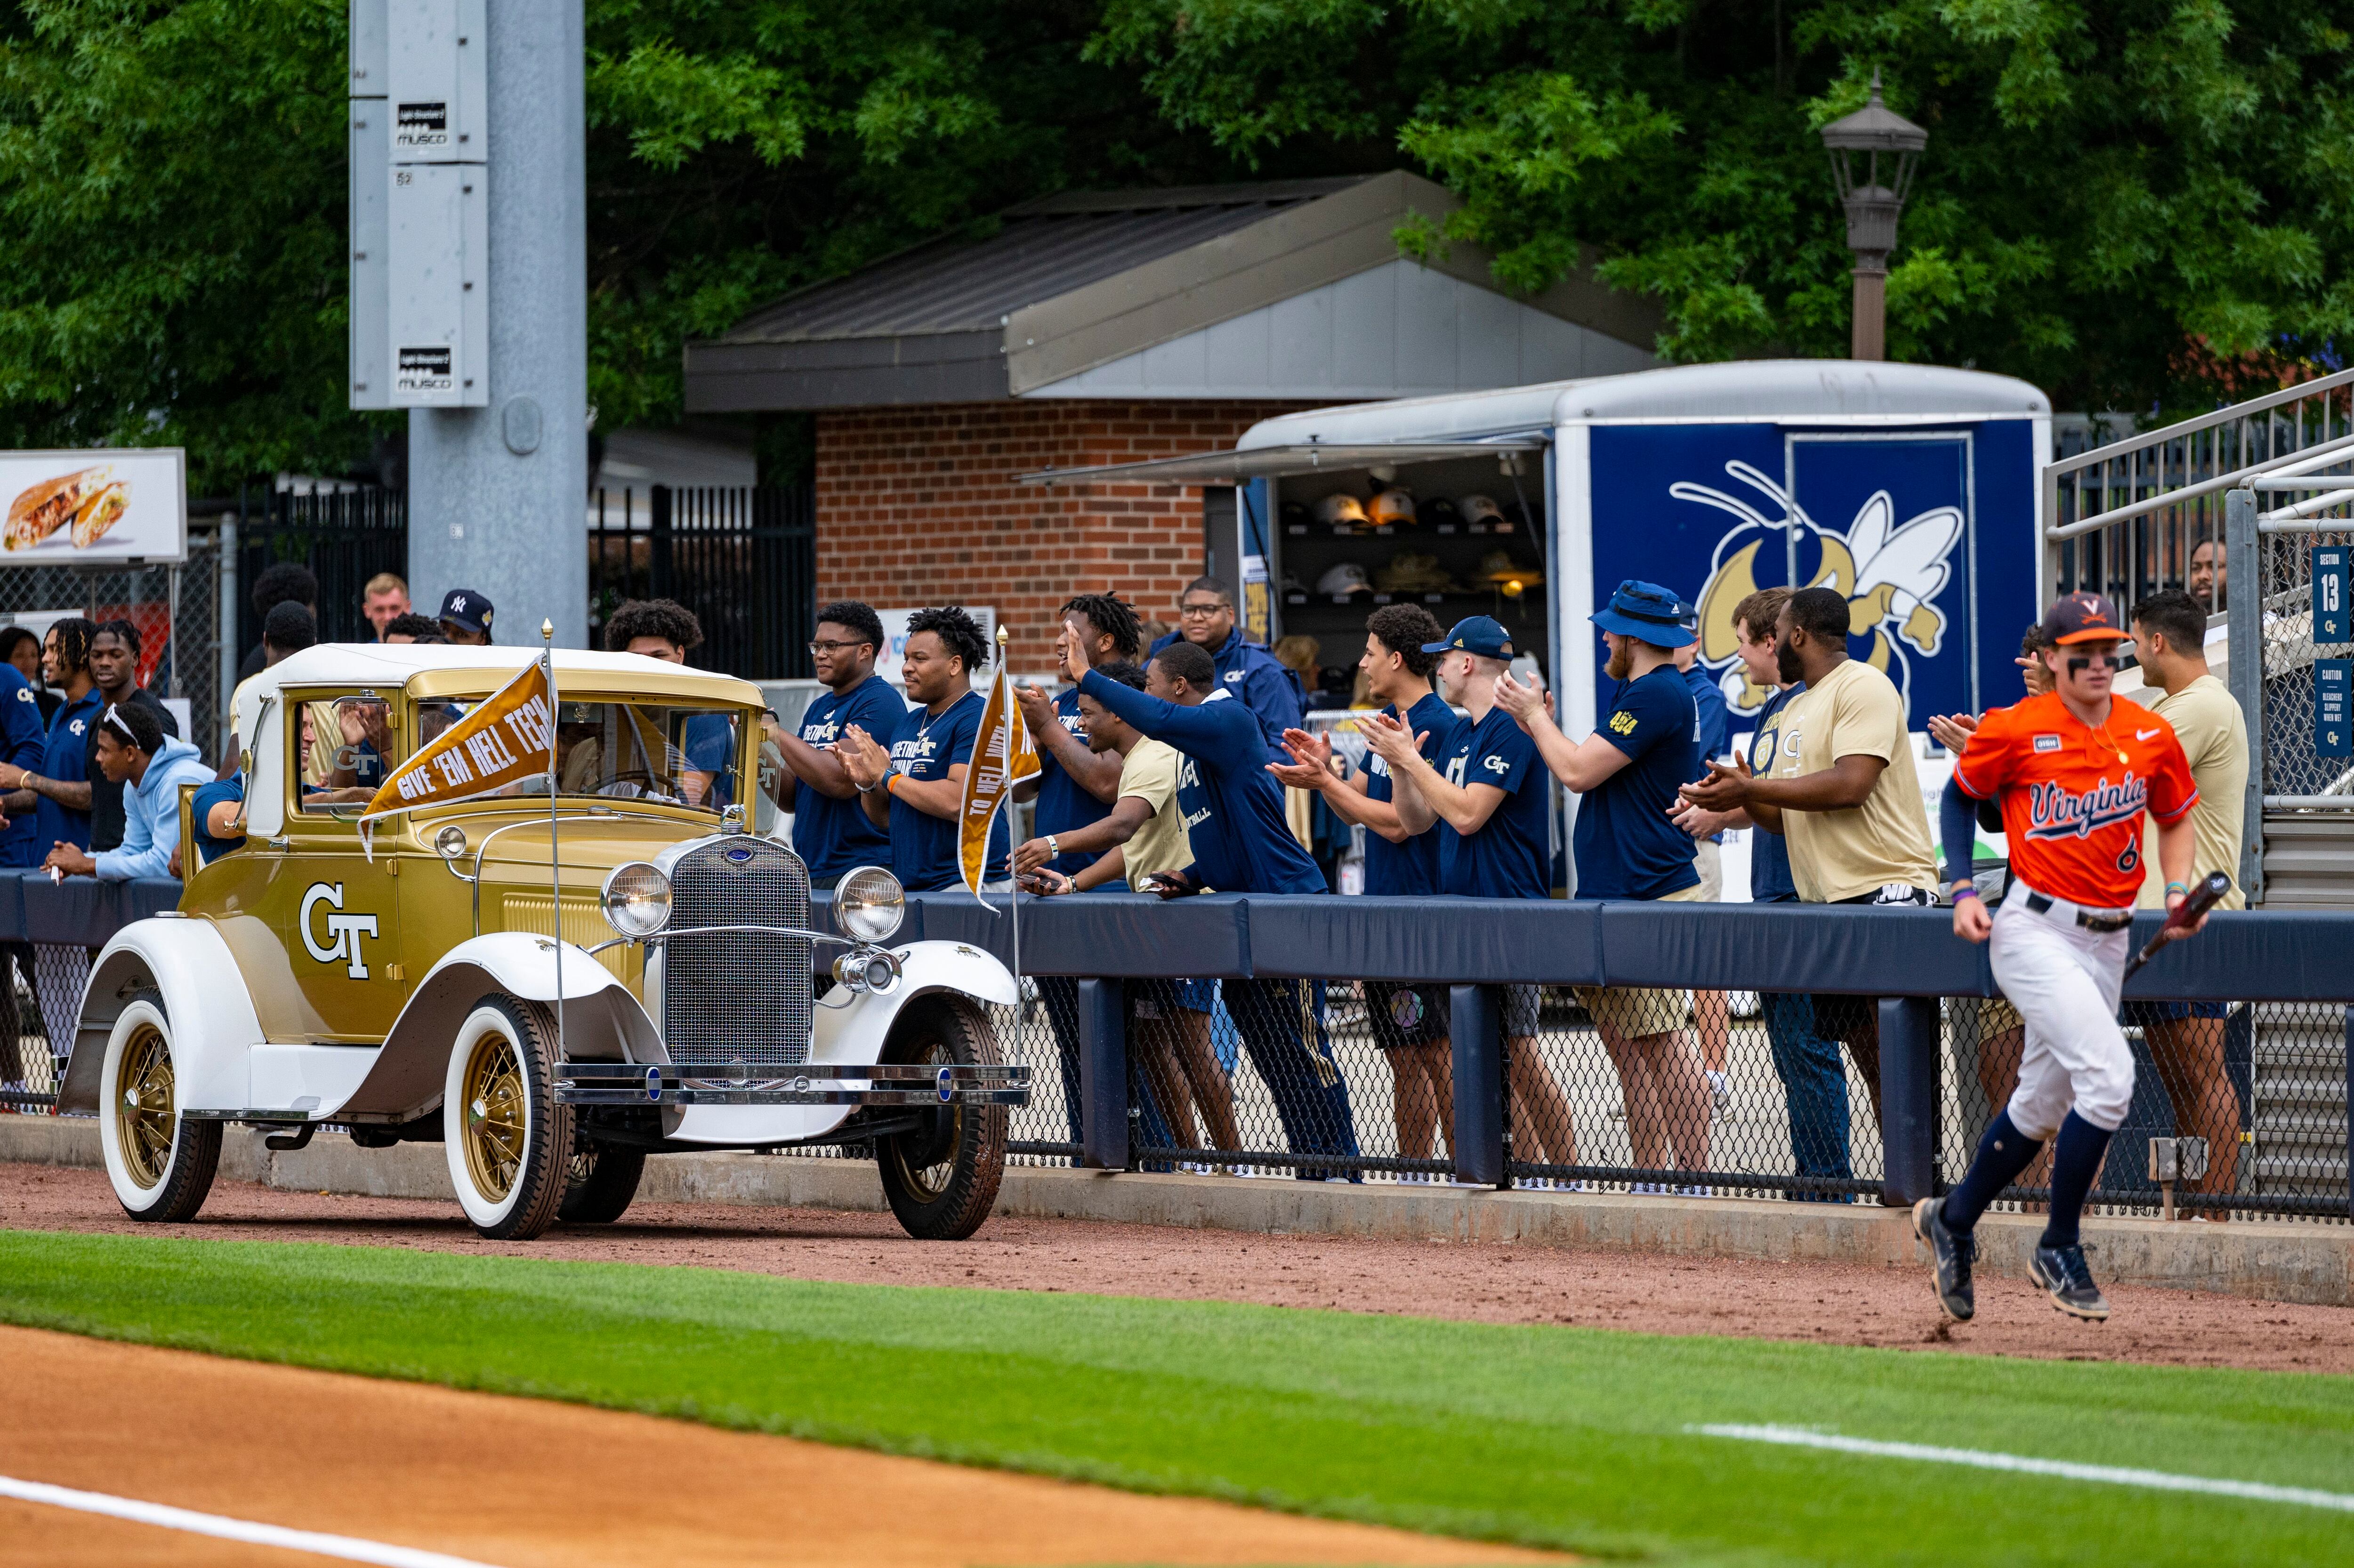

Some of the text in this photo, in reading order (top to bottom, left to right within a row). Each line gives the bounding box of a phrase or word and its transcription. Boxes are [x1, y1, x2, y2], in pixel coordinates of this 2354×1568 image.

[2320, 554, 2339, 565] SECTION
[2322, 573, 2339, 611] 13
[451, 595, 466, 612] NY
[2080, 599, 2098, 615] V
[2325, 619, 2336, 634] GT
[1223, 669, 1246, 682] GT
[2322, 669, 2342, 680] CAUTION
[17, 688, 34, 703] GT
[2322, 692, 2342, 701] BLEACHERS
[2324, 703, 2341, 712] SLIPPERY
[1610, 711, 1638, 736] 404
[2323, 713, 2334, 721] WHEN
[70, 719, 86, 736] GT
[822, 720, 839, 740] GT
[396, 693, 550, 800] GIVE 'EM HELL TECH
[916, 736, 936, 756] GT
[2327, 731, 2338, 746] GT
[331, 745, 377, 775] GT
[1484, 755, 1510, 774] GT
[969, 799, 992, 815] TO
[2030, 771, 2148, 840] Virginia
[1185, 807, 1212, 830] OTBALL
[2117, 833, 2138, 874] 6
[298, 881, 379, 981] GT
